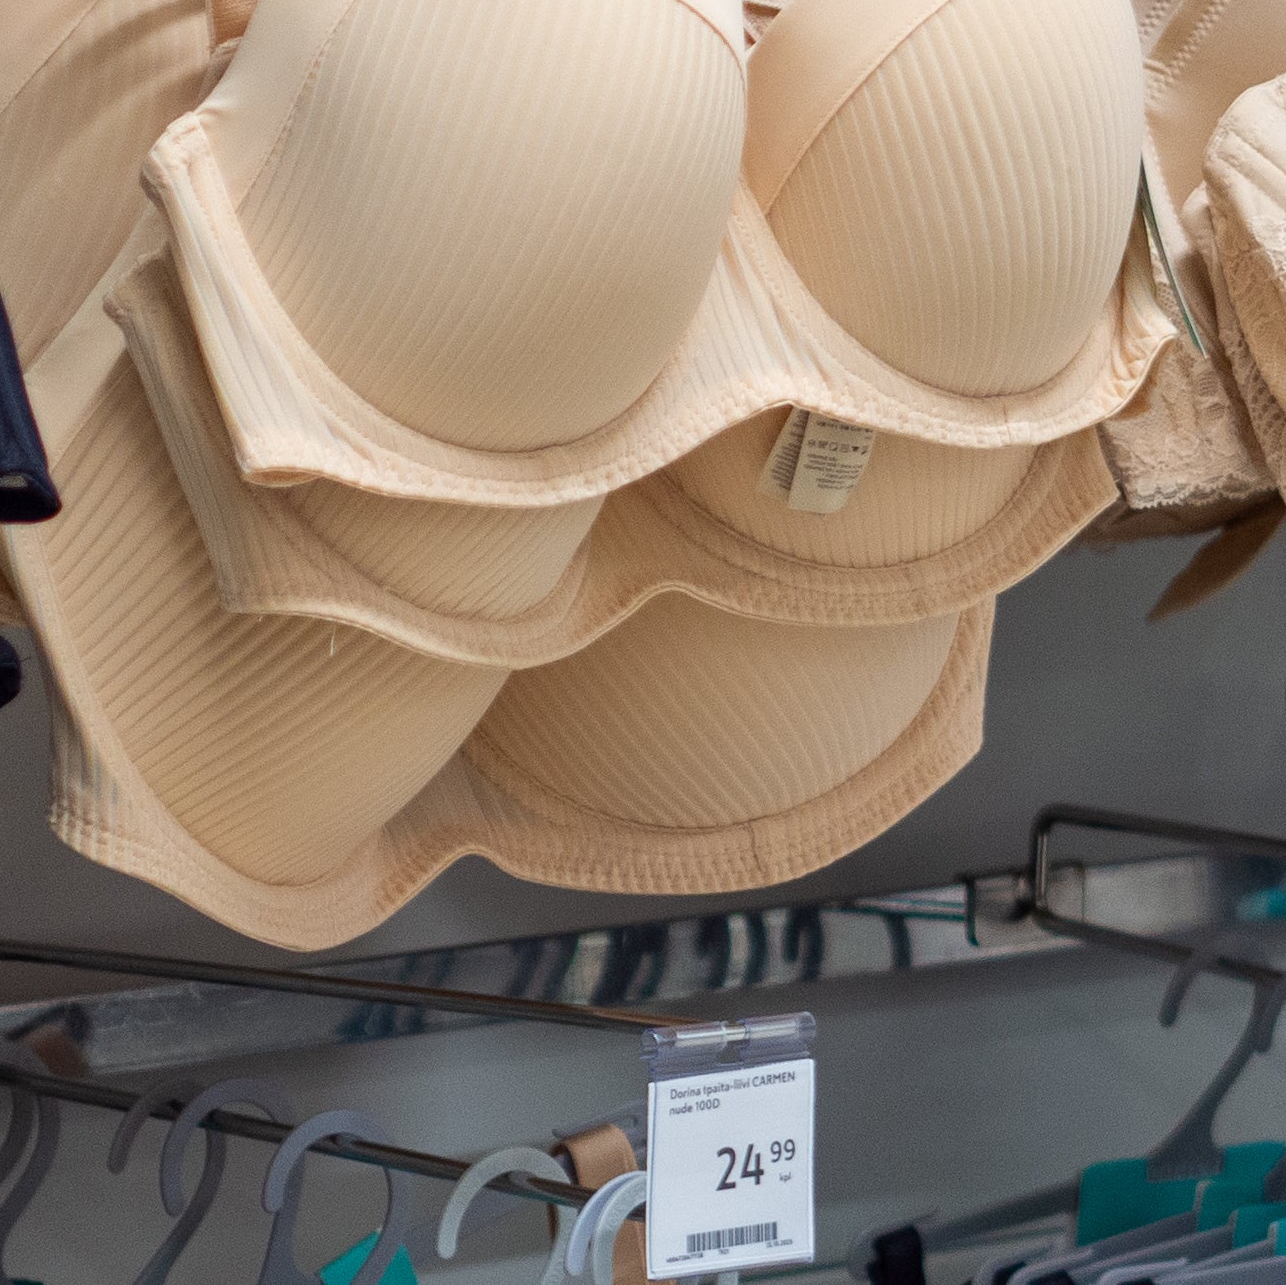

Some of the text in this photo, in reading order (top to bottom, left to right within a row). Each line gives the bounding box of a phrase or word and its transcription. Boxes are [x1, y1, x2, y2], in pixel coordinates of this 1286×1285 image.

[670, 1089, 701, 1100] Dorina
[752, 1071, 796, 1087] CARMEN
[669, 1098, 720, 1116] nude 100D
[715, 1139, 796, 1191] 24 99
